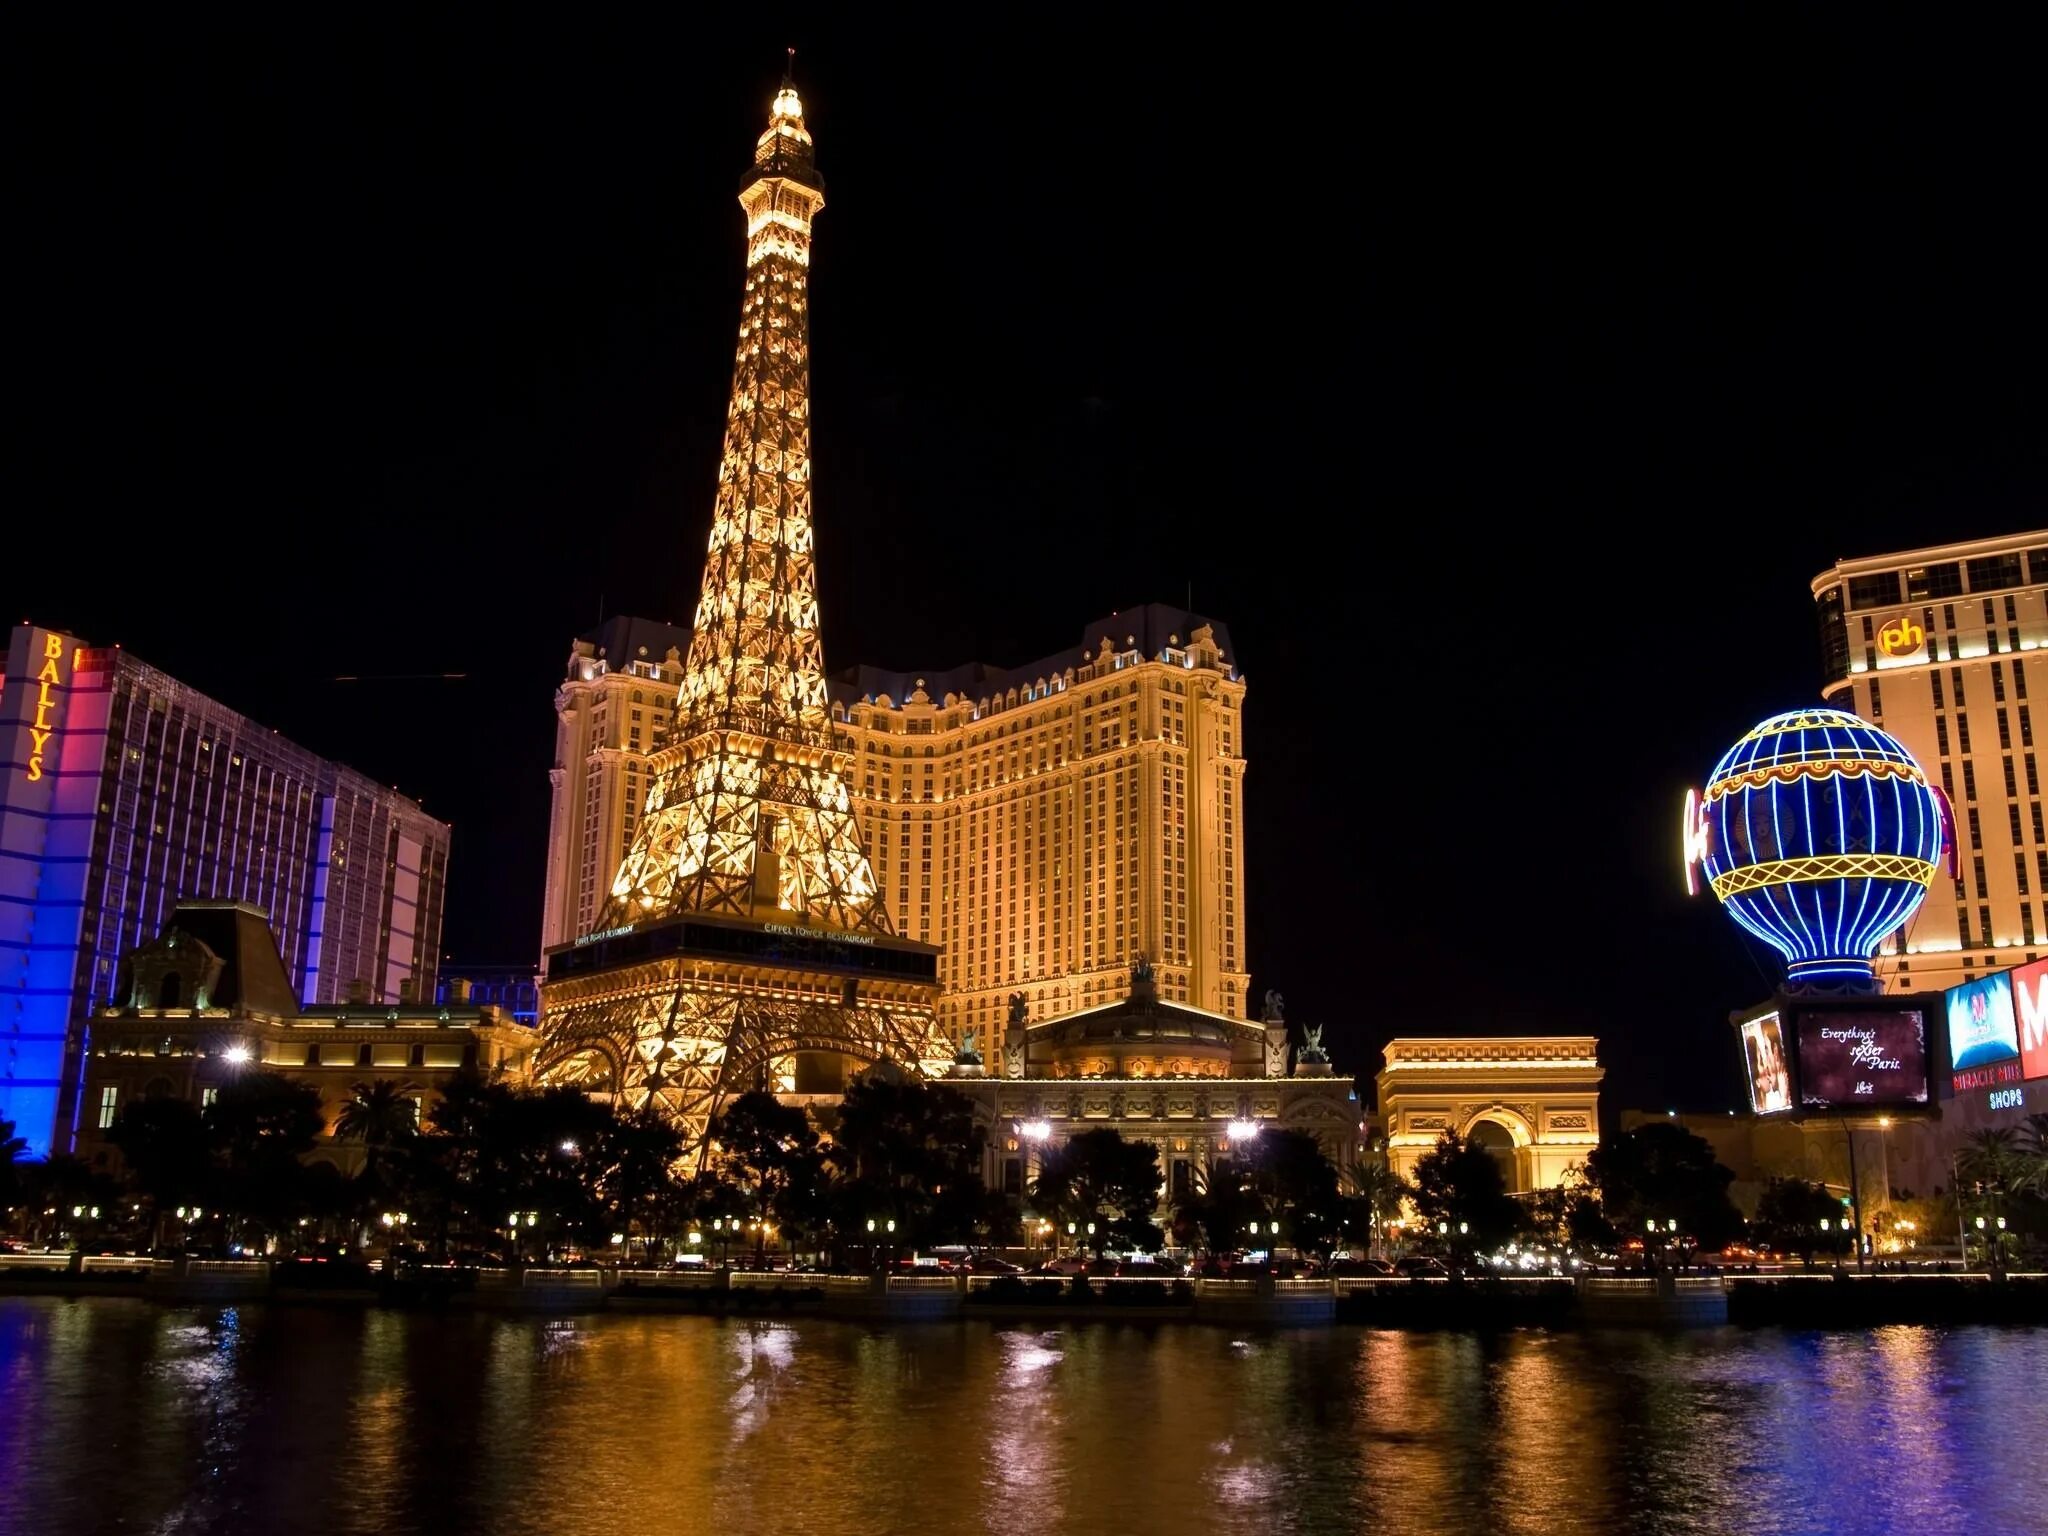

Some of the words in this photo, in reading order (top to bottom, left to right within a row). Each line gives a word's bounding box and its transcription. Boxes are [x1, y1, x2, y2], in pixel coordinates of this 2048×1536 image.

[1882, 618, 1922, 653] ph
[27, 633, 62, 782] BALLYS
[764, 923, 793, 936] EIFFEL
[795, 926, 824, 939] TOWER
[826, 932, 876, 945] RESTAURANT
[1821, 1026, 1876, 1045] Everything's
[1866, 1056, 1901, 1070] Paris.
[1953, 1067, 1996, 1090] MIRACLE
[1997, 1064, 2022, 1083] MILE
[1989, 1088, 2023, 1110] SHOPS
